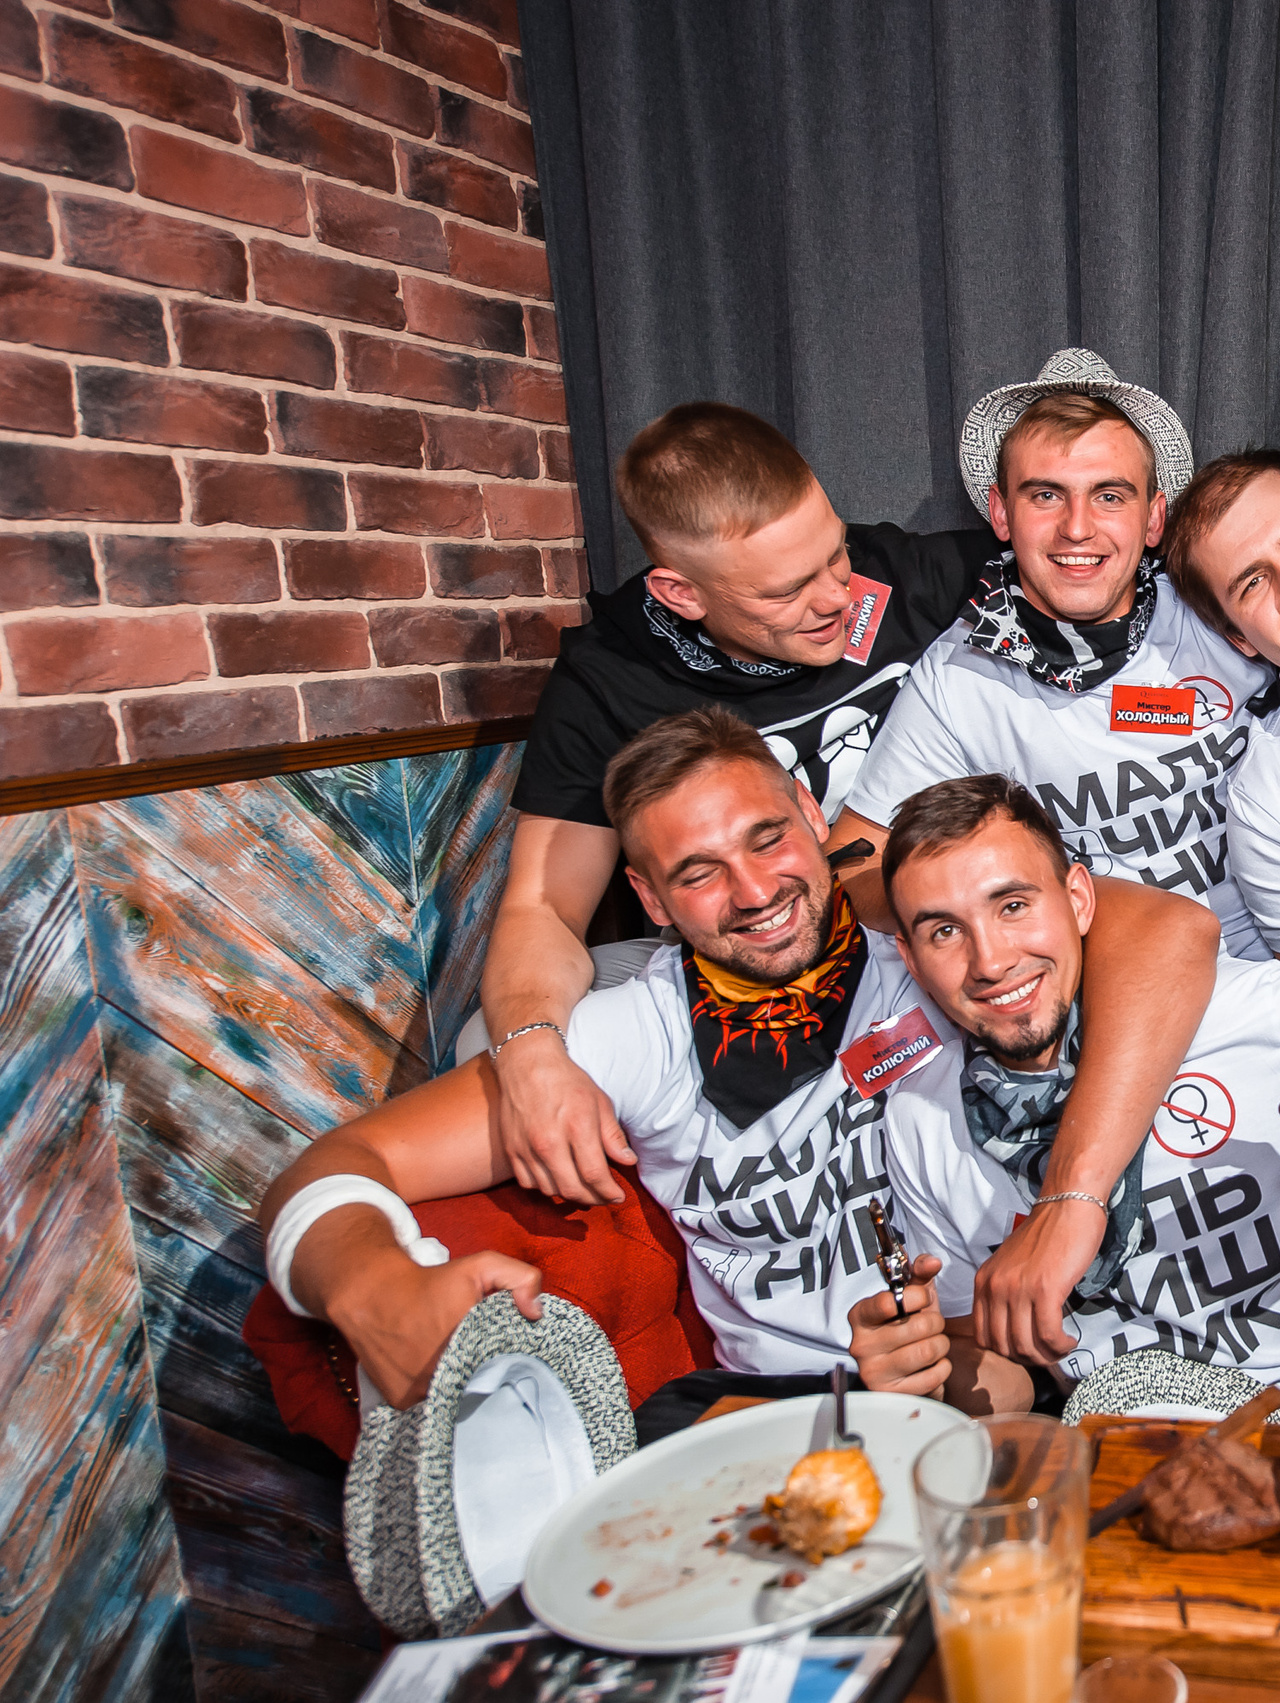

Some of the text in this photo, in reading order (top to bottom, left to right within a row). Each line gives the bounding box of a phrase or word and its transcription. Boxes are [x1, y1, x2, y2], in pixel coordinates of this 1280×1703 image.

[850, 593, 877, 648] ЛИПКИЙ
[1116, 710, 1190, 725] ХОЛОДНЫЙ
[1137, 702, 1171, 712] Мистер
[1035, 725, 1250, 830] МАЛЬ
[862, 1035, 931, 1083] КОЛЮЧИЙ
[872, 1037, 908, 1061] Мистер
